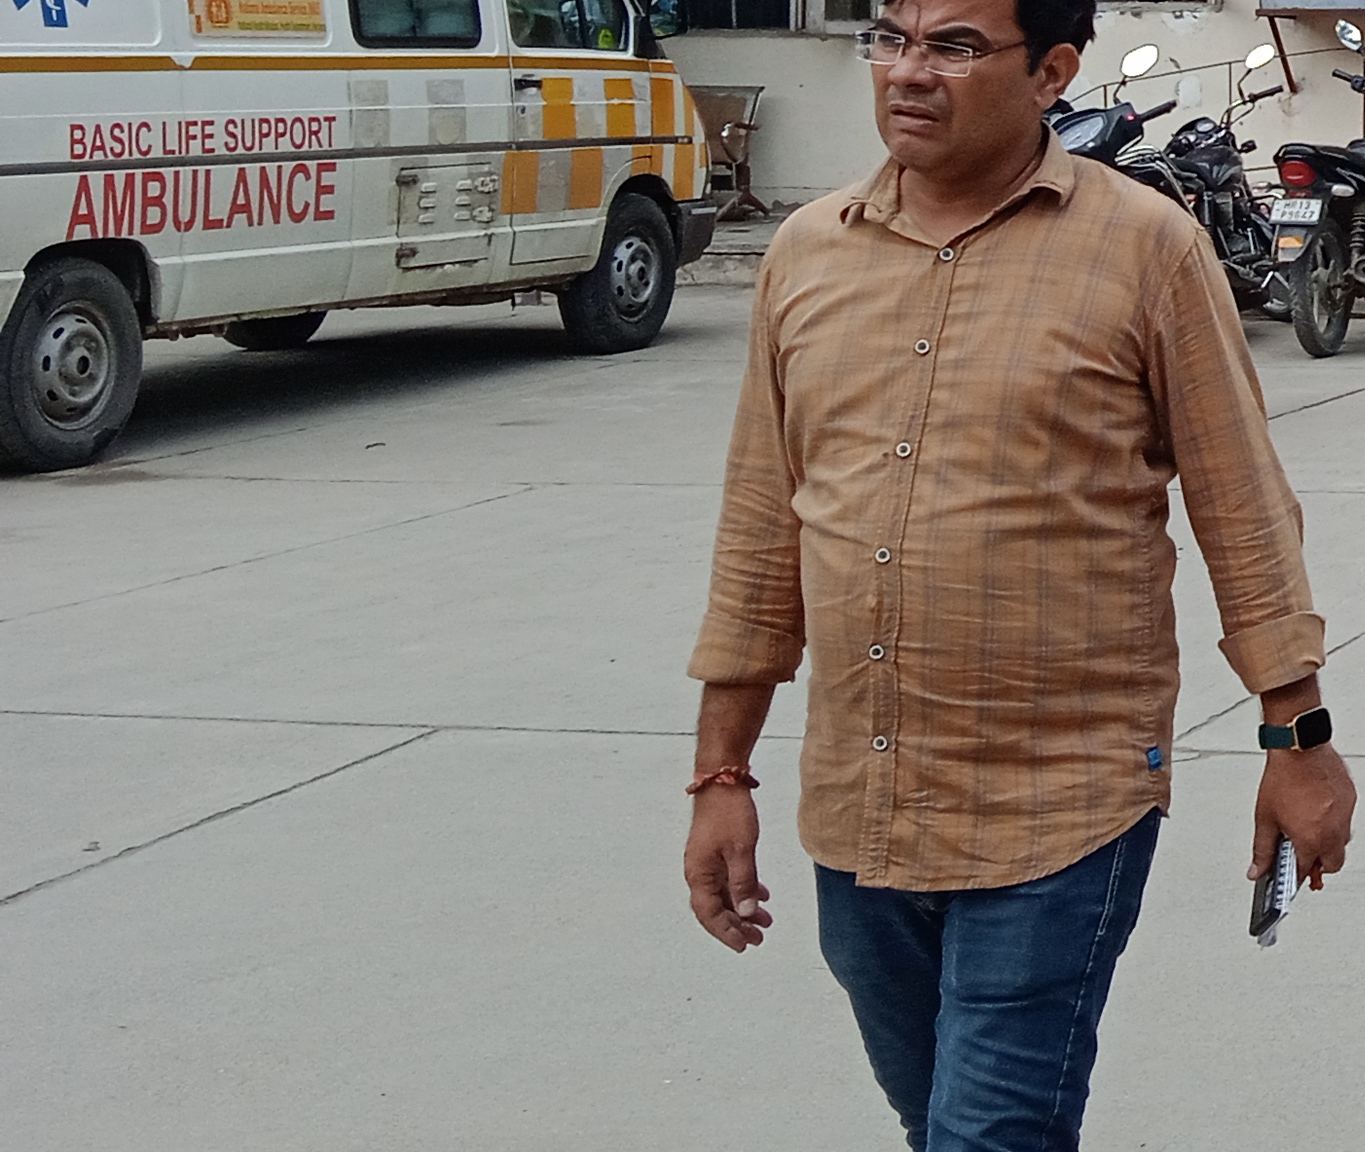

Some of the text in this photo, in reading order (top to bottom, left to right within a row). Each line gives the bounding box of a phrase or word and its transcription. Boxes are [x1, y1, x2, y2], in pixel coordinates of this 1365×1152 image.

[69, 116, 337, 160] BASIC LIFE SUPPORT
[65, 162, 337, 242] AMBULANCE
